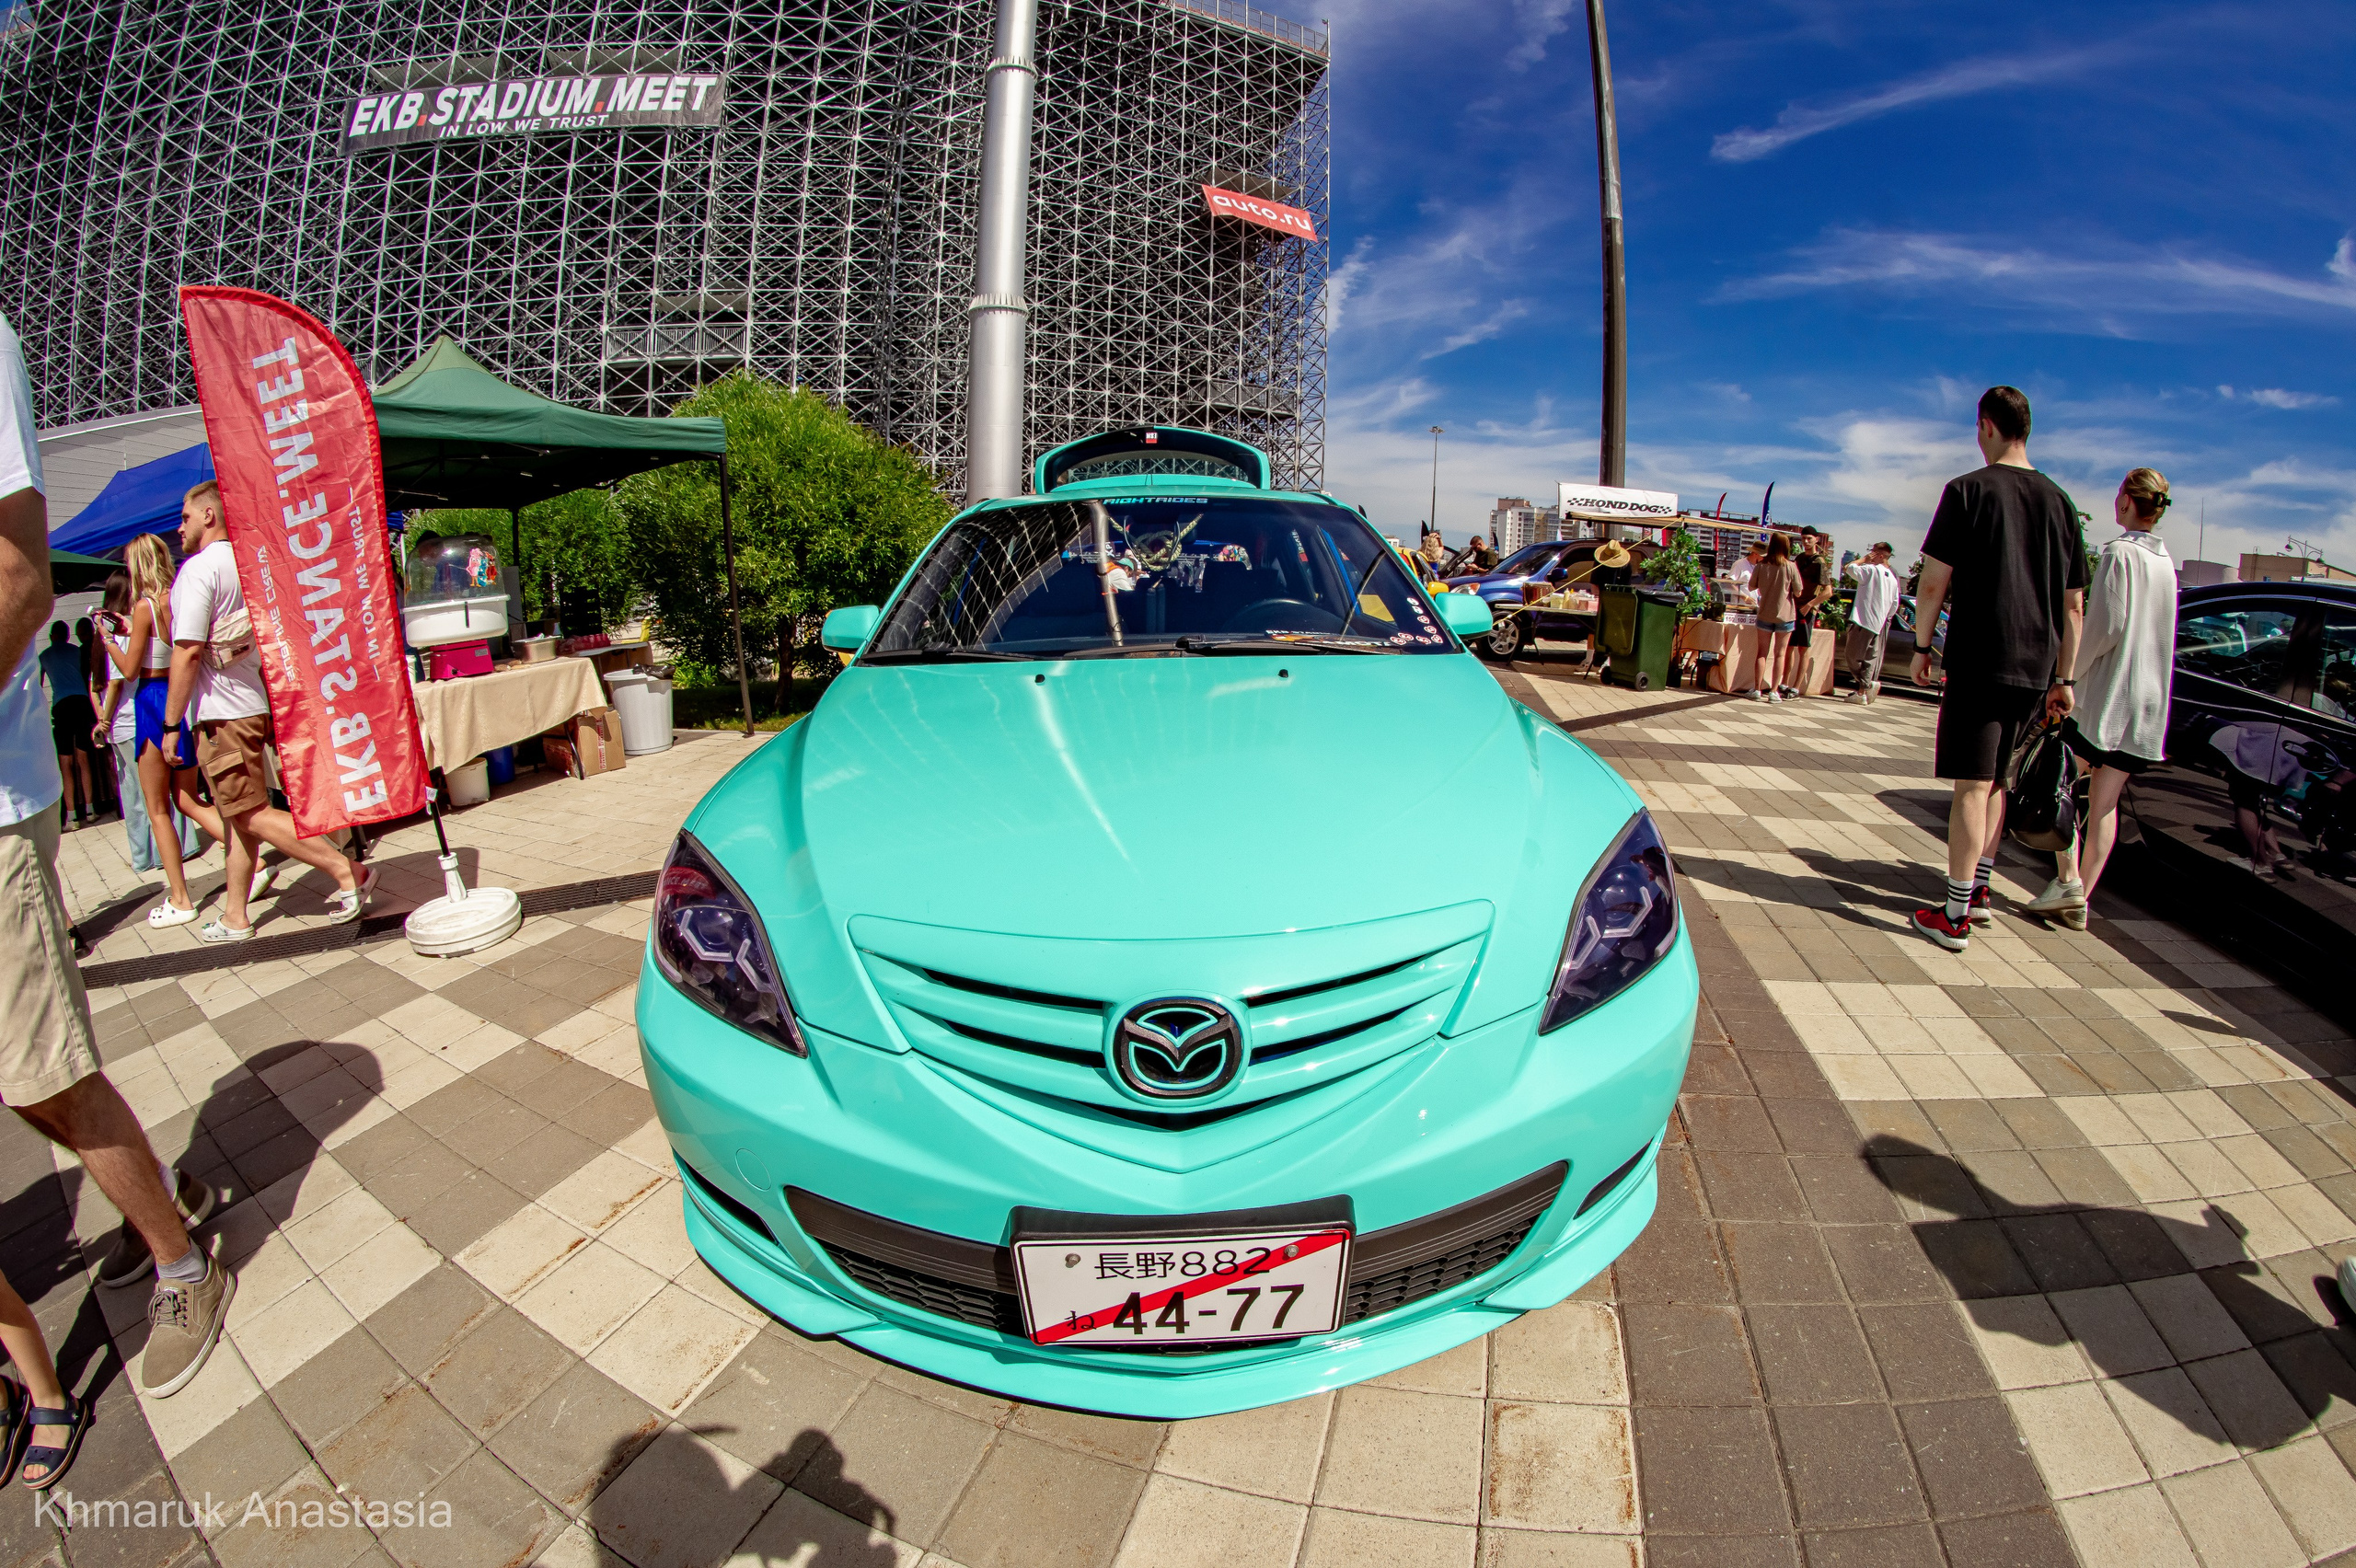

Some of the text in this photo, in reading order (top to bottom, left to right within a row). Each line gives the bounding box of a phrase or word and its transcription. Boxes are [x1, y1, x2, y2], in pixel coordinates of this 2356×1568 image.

[349, 76, 718, 138] EKB.STADIUM.MEET
[440, 114, 609, 138] IN LOW WE TRUST
[1212, 194, 1311, 232] auto.ru
[1628, 502, 1659, 513] DOG
[1113, 1284, 1305, 1335] 44-77
